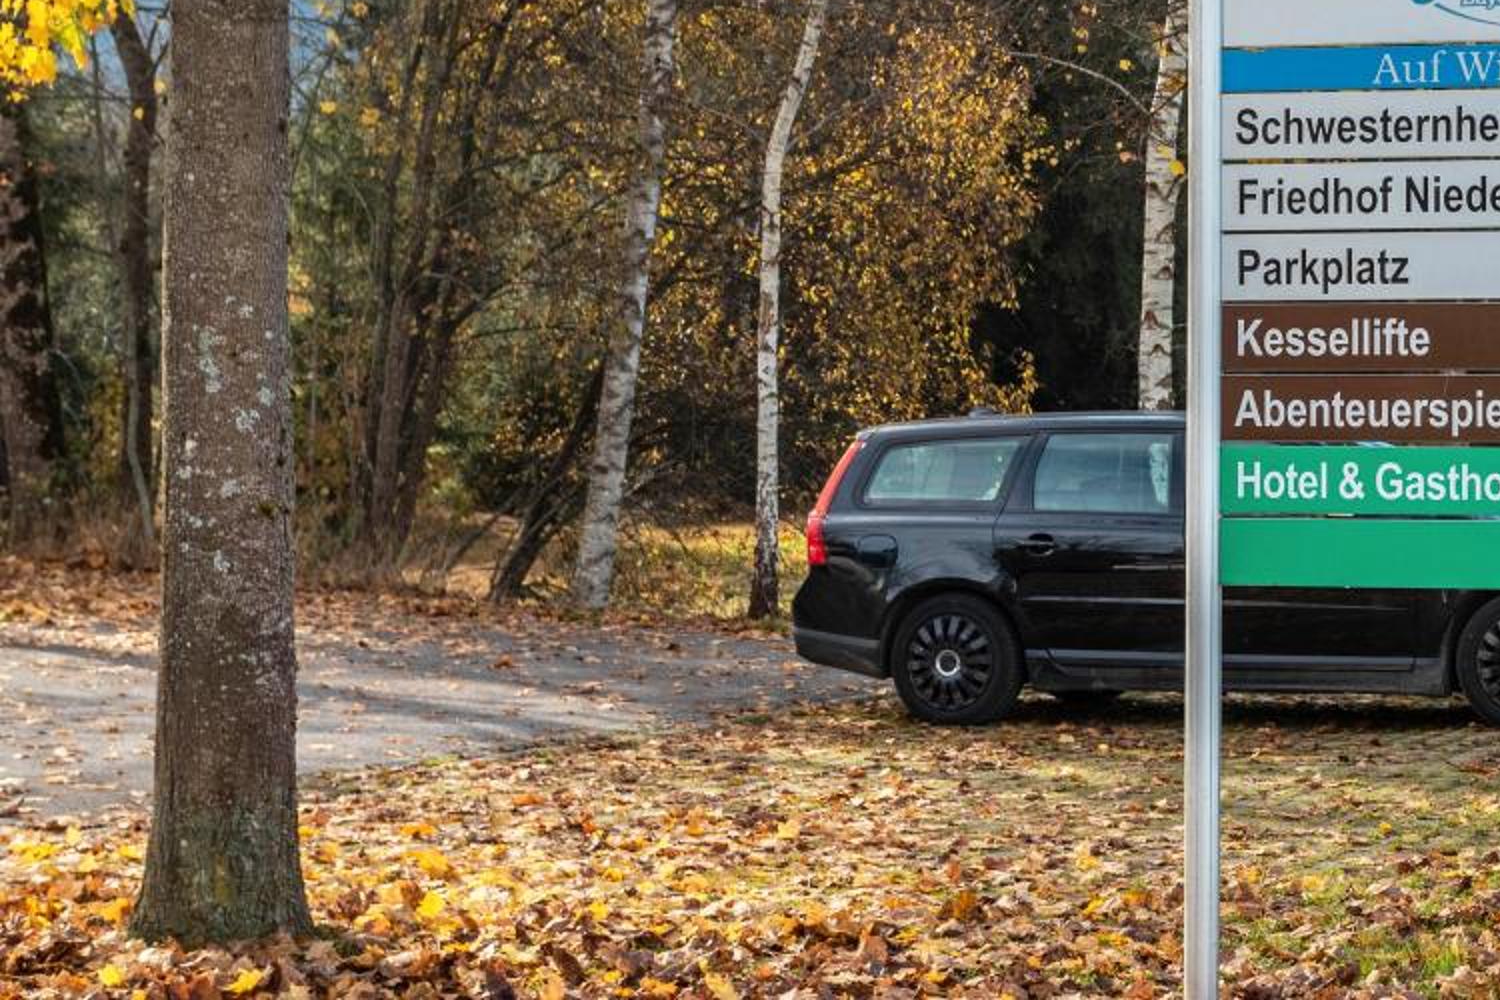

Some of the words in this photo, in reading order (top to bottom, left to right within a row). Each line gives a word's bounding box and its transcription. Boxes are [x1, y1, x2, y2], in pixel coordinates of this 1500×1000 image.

[1373, 49, 1449, 86] Auf
[1237, 177, 1392, 215] Friedhof
[1237, 248, 1409, 294] Parkplatz
[1236, 317, 1430, 357] Kessellifte
[1236, 460, 1327, 500] Hotel
[1339, 463, 1365, 500] &
